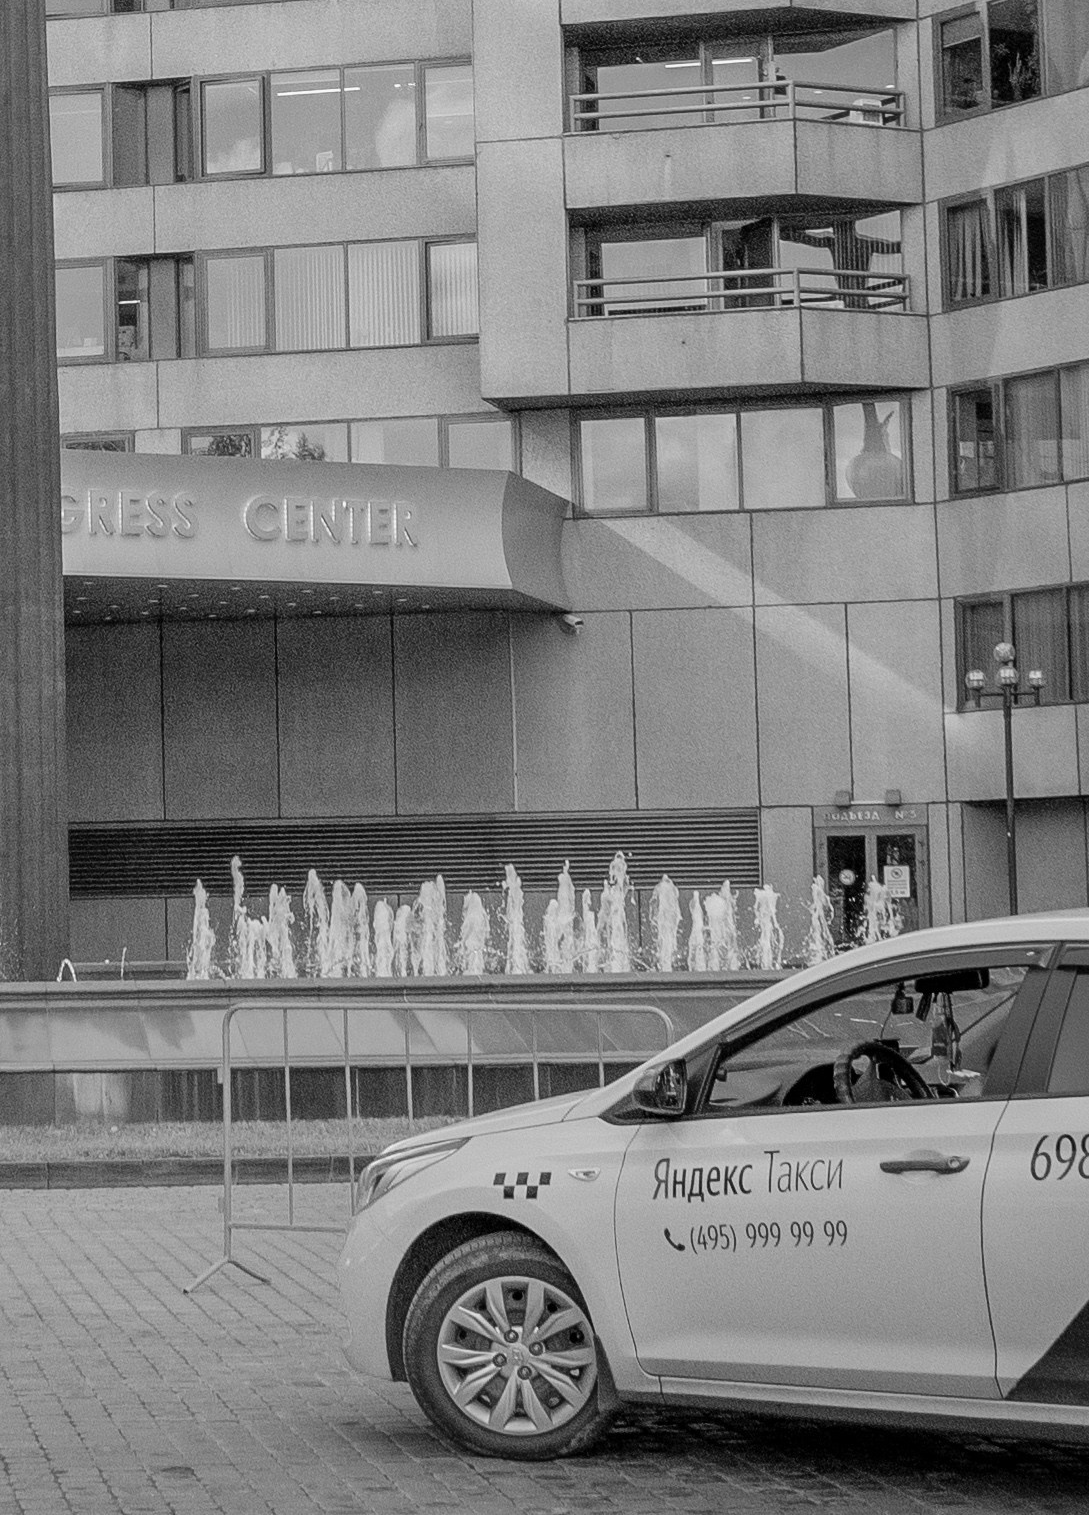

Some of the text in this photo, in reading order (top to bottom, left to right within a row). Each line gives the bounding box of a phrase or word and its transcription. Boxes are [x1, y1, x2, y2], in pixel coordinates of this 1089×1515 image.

[243, 494, 418, 548] CENTER
[652, 1150, 843, 1203] Яндекс Такси
[690, 1220, 847, 1254] (495) 999 99 99
